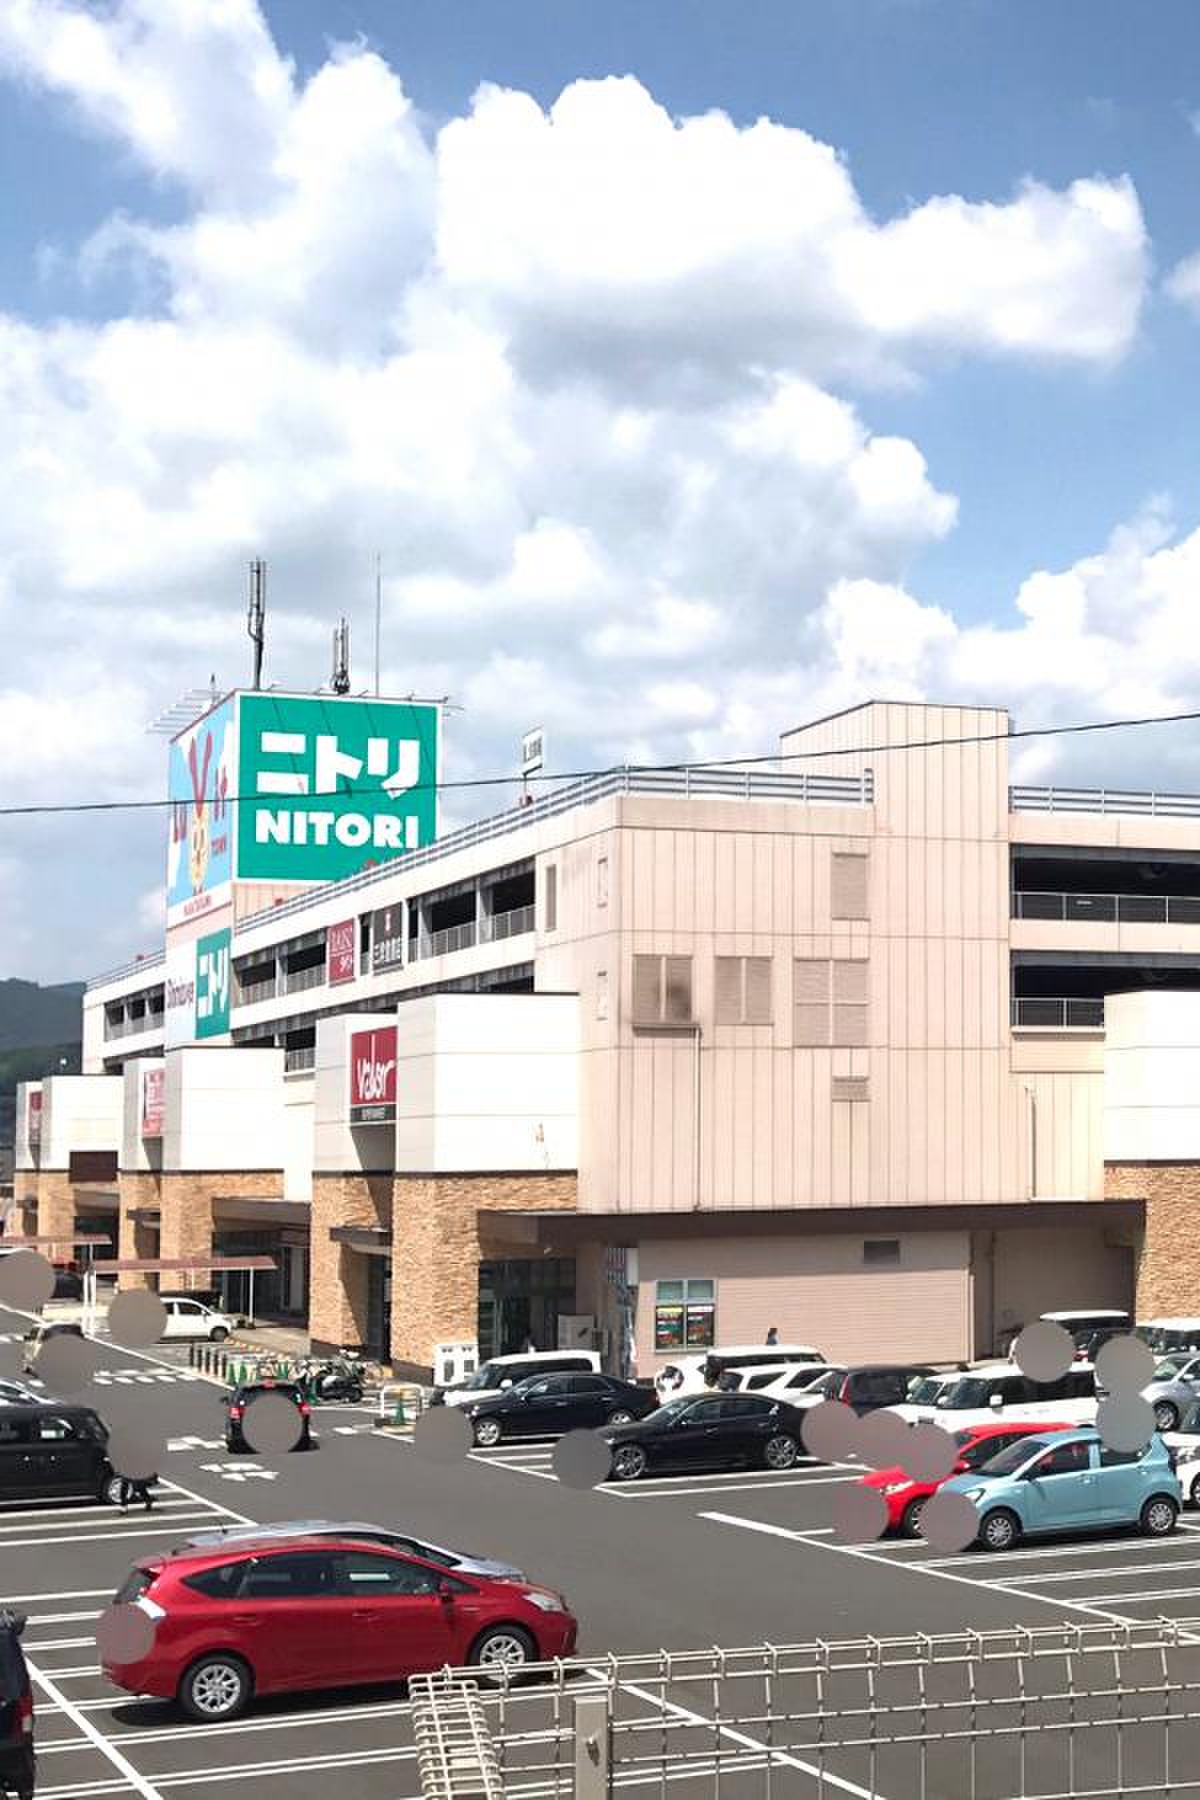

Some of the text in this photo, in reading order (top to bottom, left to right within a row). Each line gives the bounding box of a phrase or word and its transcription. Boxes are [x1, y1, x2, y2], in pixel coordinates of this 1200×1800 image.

[256, 731, 420, 800] ニトリ
[255, 809, 419, 849] NITORI
[198, 946, 230, 1018] ニトリ
